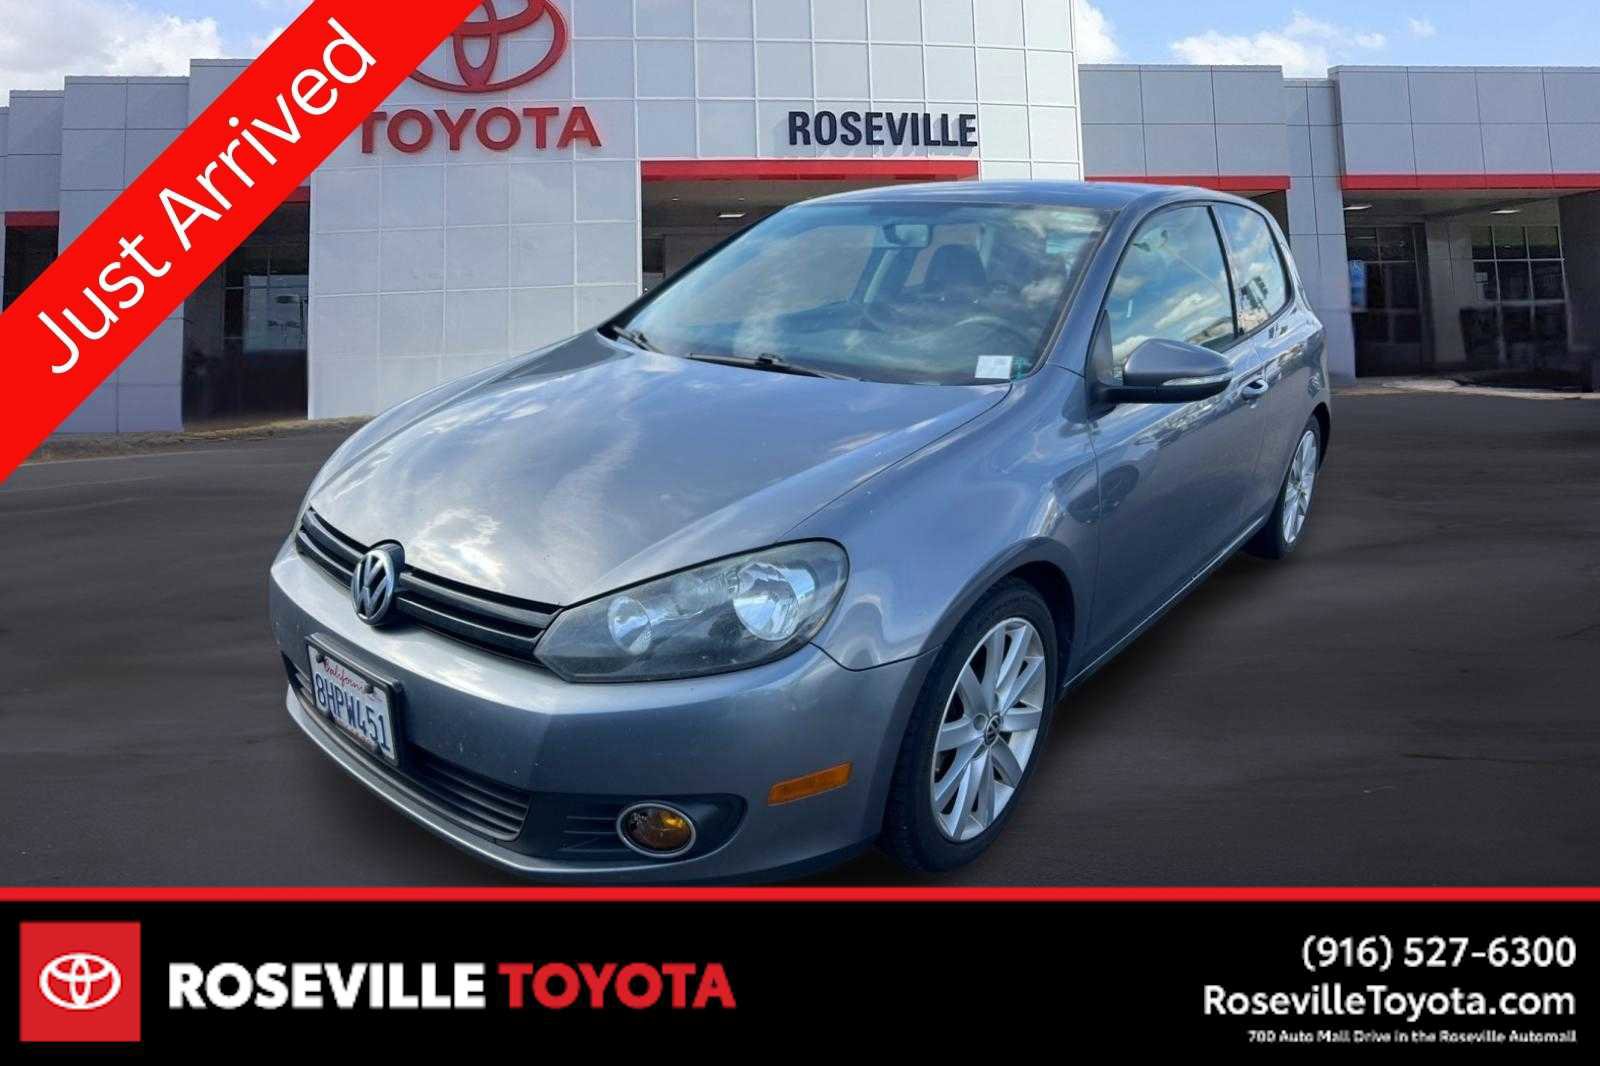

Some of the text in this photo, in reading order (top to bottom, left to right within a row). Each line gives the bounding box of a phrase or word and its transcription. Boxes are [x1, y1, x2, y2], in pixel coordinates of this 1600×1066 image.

[361, 106, 602, 154] TOYOTA
[788, 111, 978, 147] ROSEVILLE
[315, 672, 391, 752] 8HPW451
